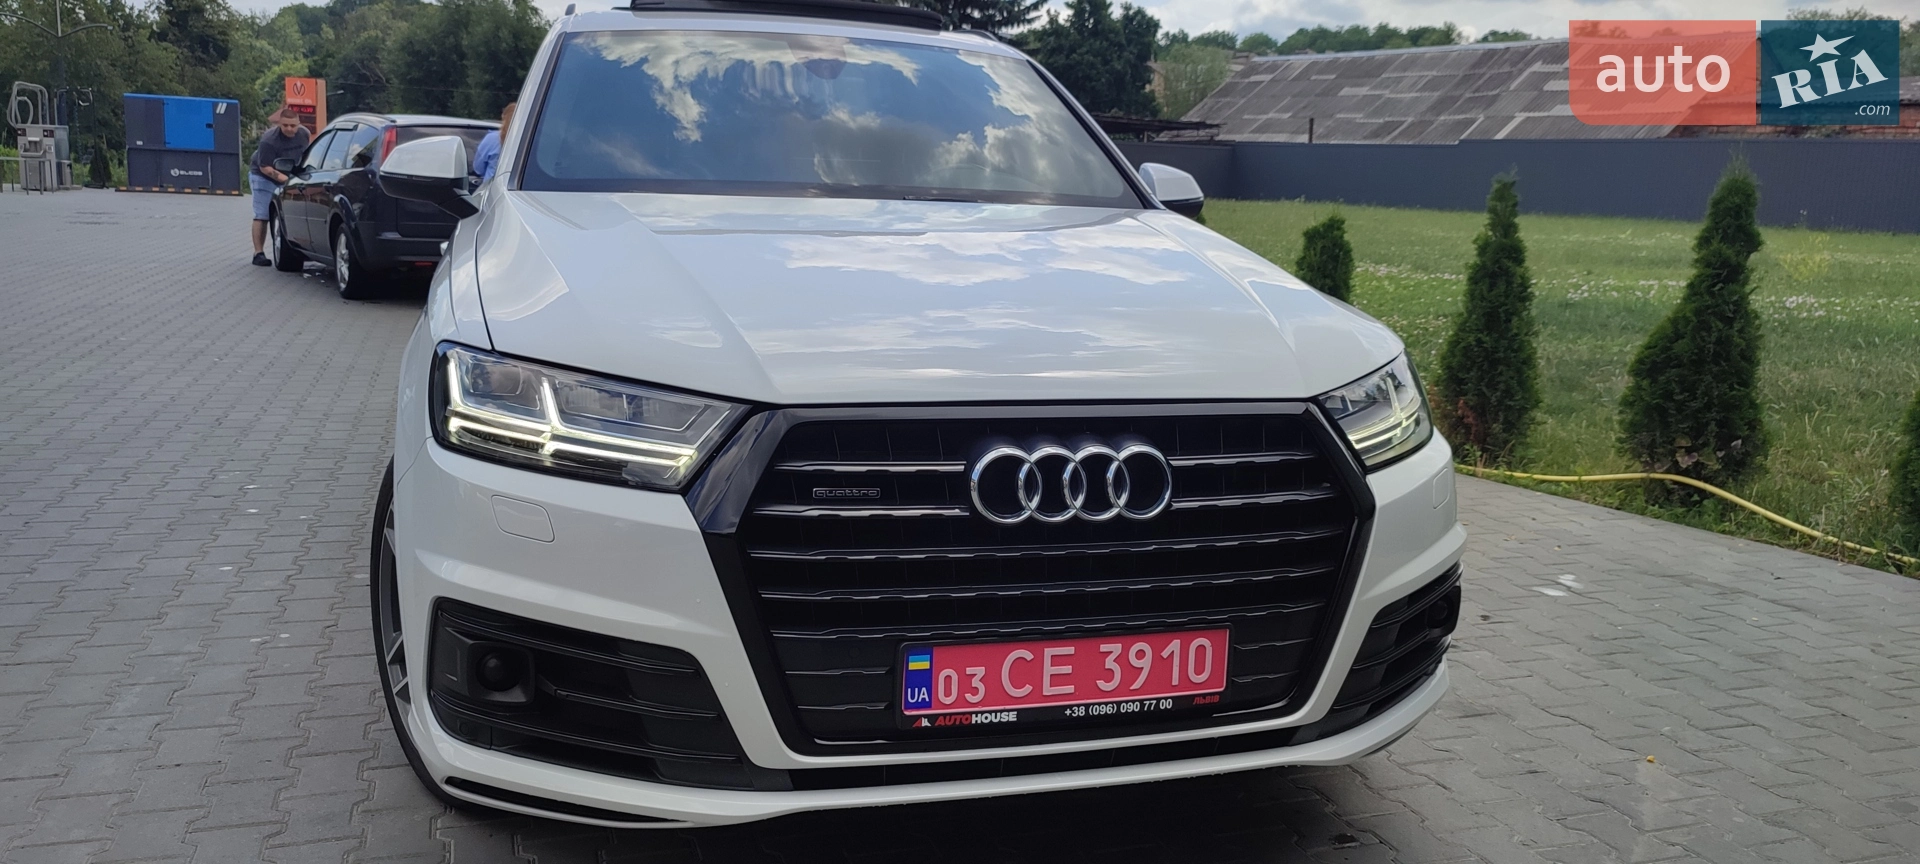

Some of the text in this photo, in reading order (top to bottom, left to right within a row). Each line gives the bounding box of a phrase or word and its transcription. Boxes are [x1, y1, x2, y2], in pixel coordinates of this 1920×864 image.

[816, 489, 878, 498] quattro
[937, 637, 1213, 705] 03 CE 3910
[907, 687, 930, 703] UA
[935, 698, 1173, 726] AUTOHOUSE +38 (096) 090 77 00
